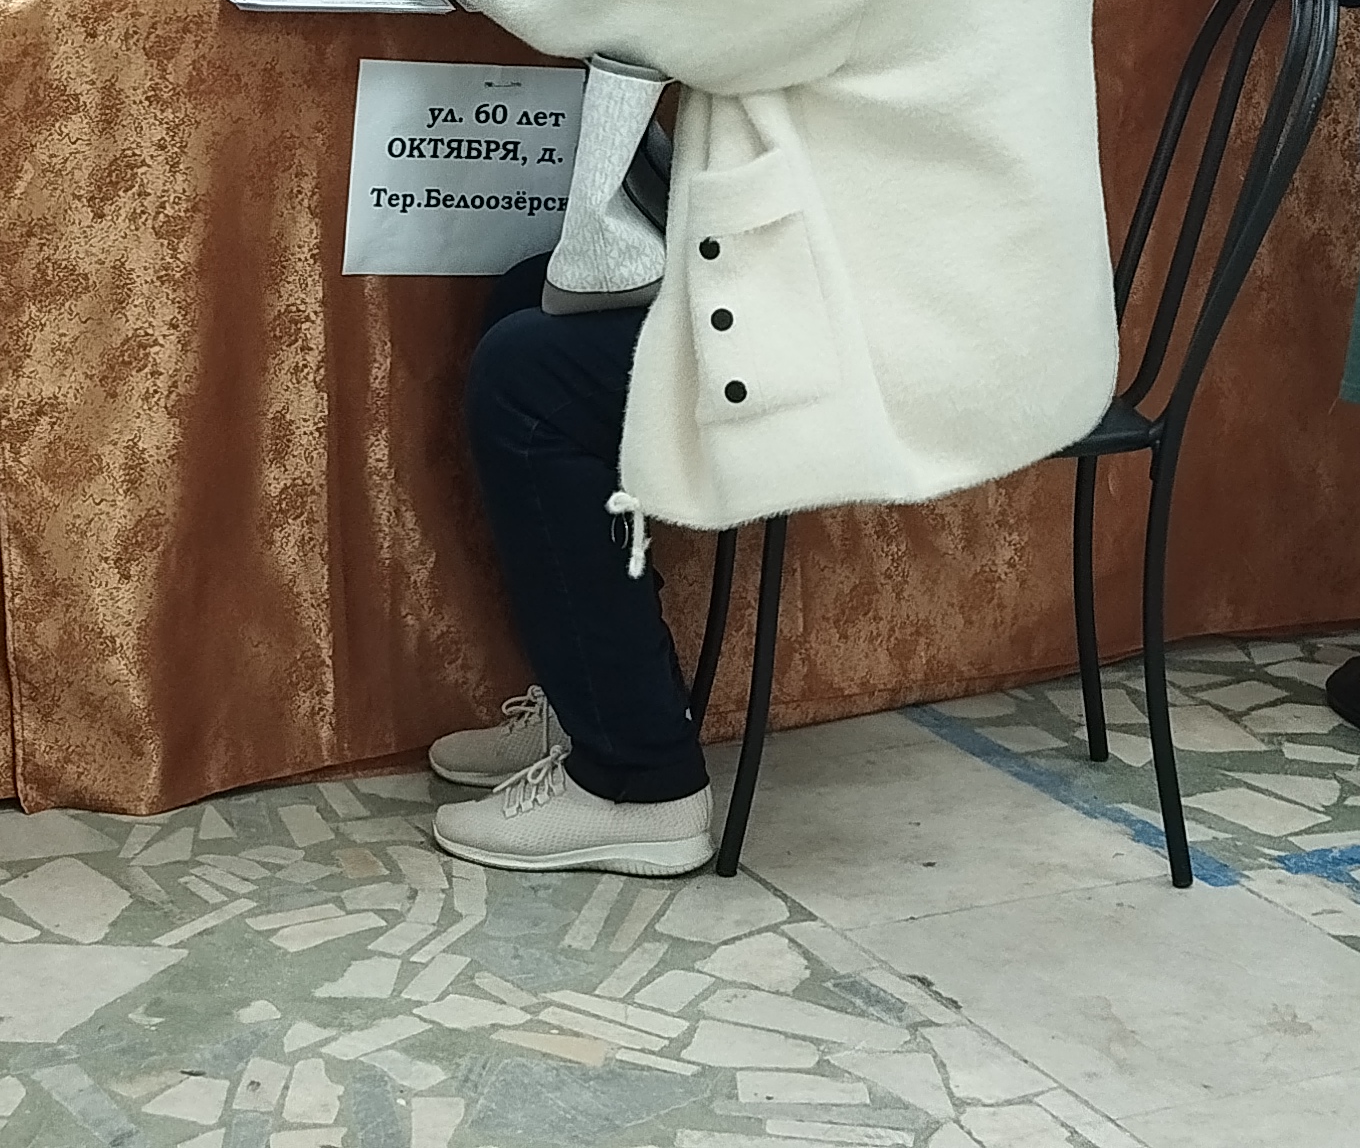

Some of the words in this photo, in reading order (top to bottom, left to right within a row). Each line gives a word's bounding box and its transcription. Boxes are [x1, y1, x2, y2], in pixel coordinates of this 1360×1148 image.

[426, 107, 464, 129] ул.
[474, 103, 508, 125] 60
[515, 110, 567, 128] лет
[387, 137, 528, 167] ОКТЯБРЯ,
[535, 147, 564, 165] д.
